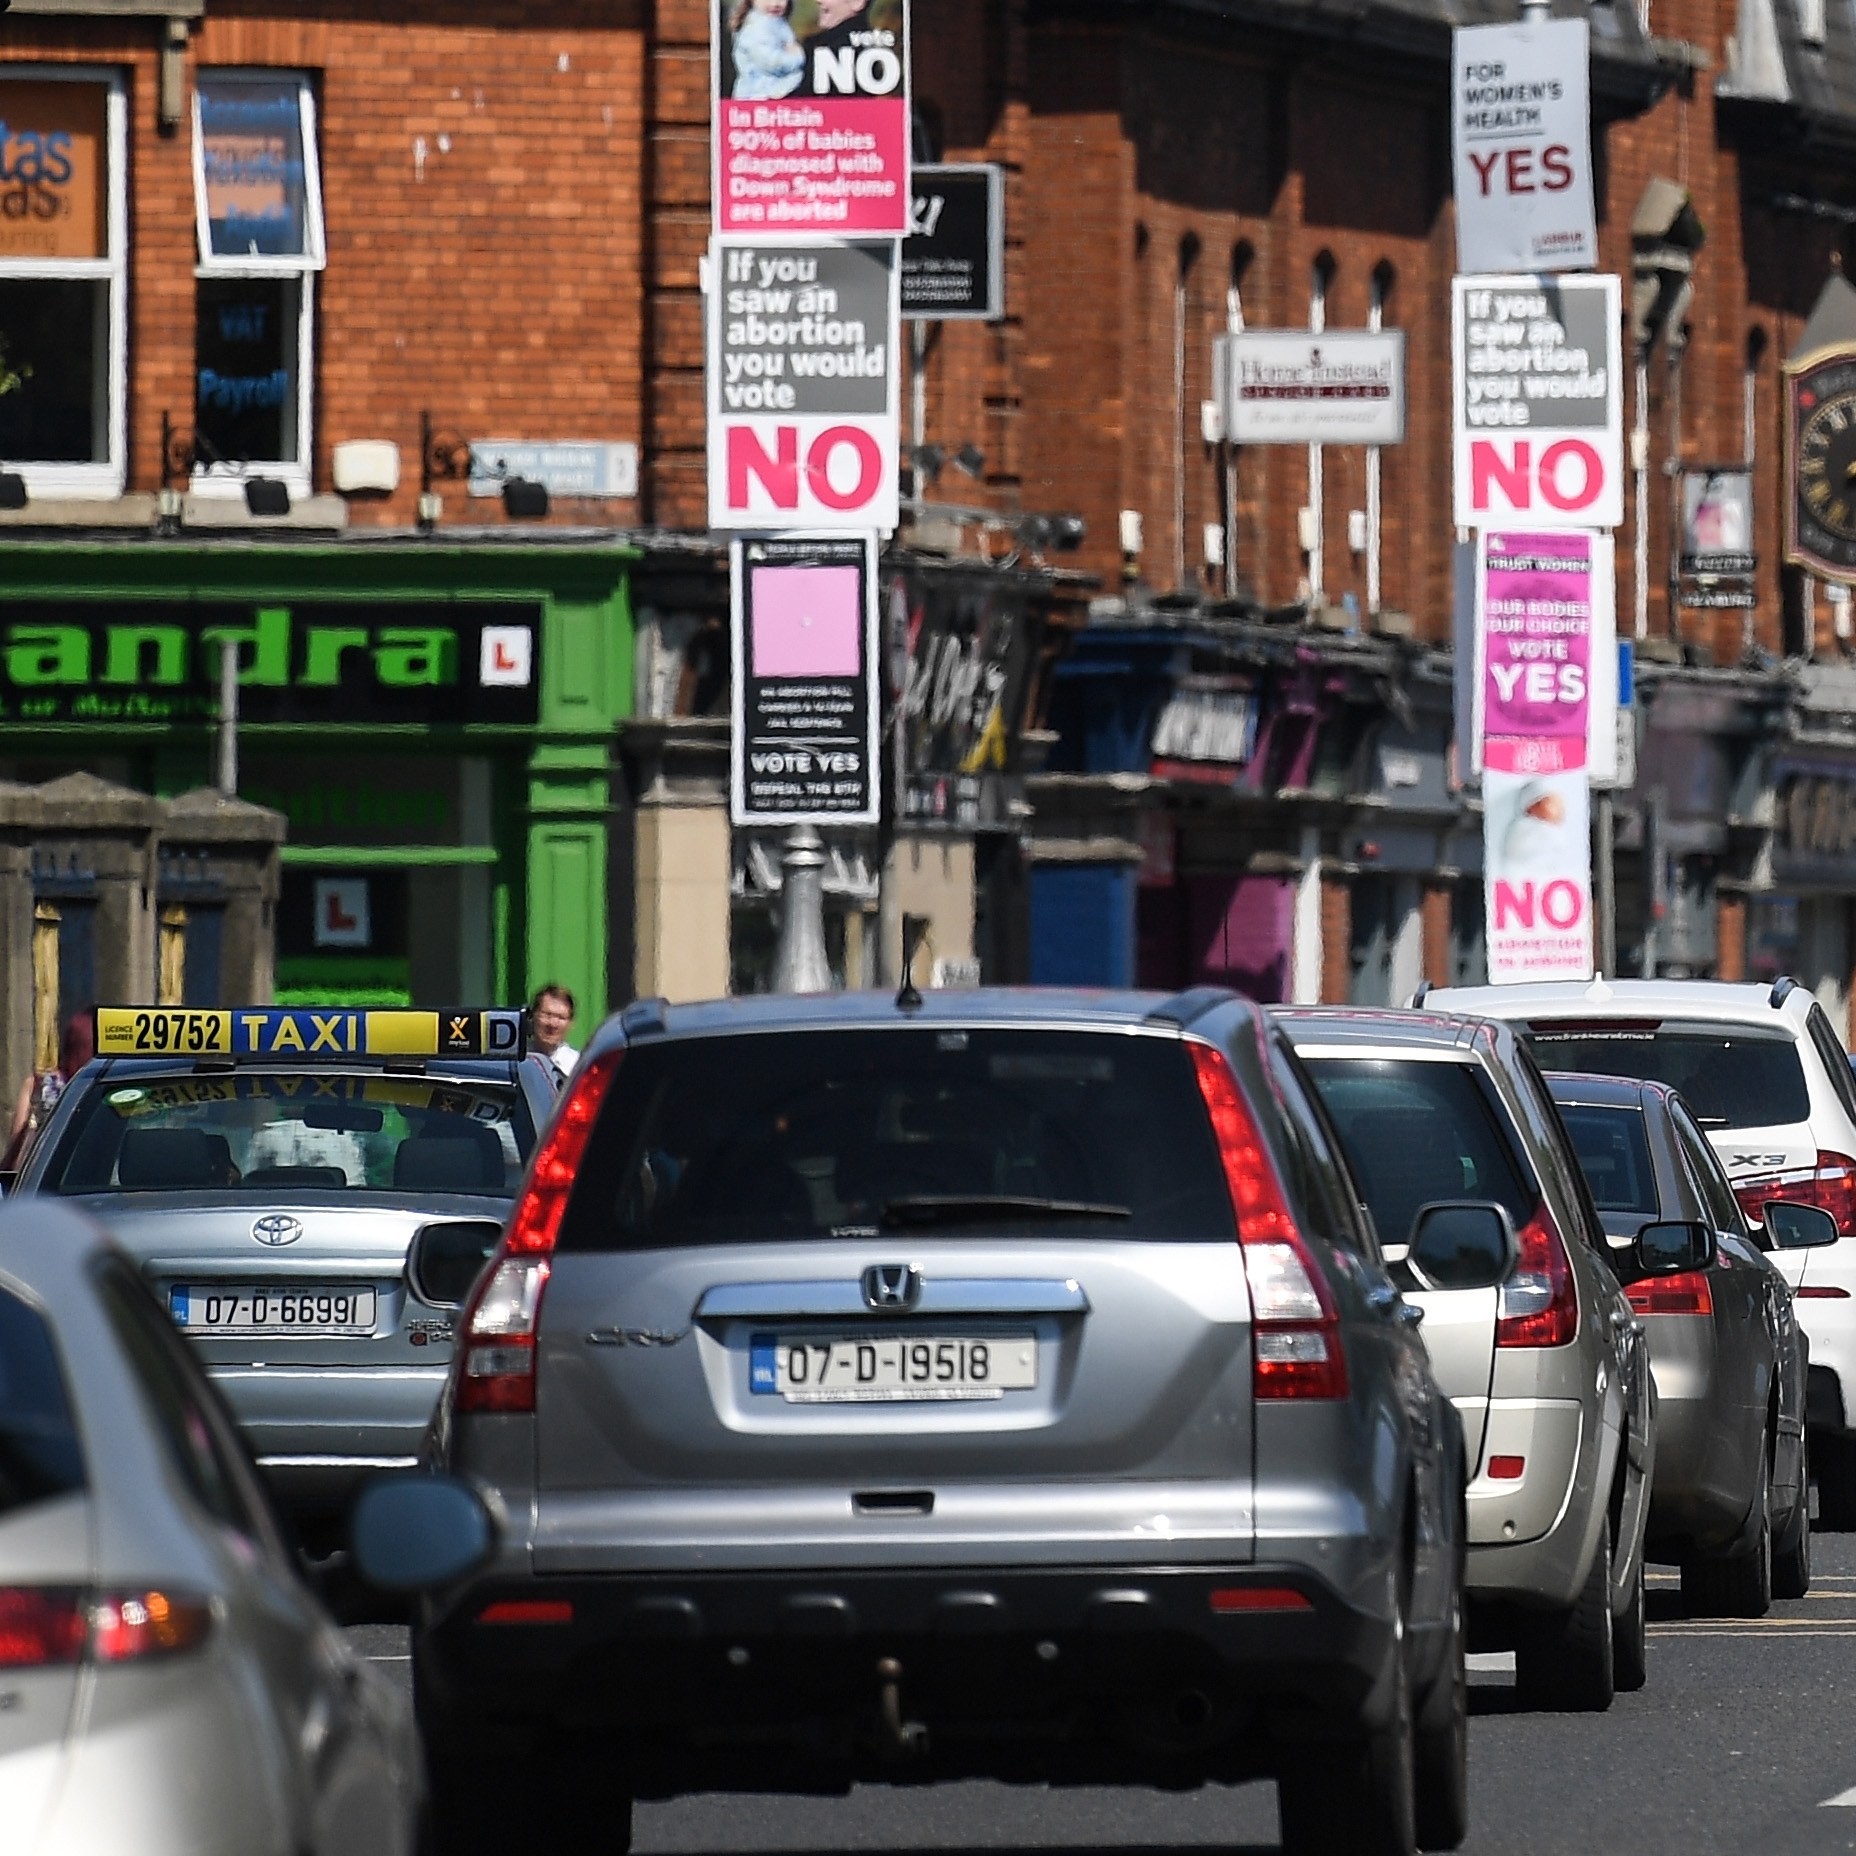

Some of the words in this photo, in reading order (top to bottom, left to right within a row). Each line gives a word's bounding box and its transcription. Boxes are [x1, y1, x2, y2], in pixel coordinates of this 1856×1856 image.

[849, 29, 895, 47] vote
[813, 46, 900, 95] NO
[1466, 64, 1505, 82] FOR
[1466, 81, 1563, 105] WOMEN'S
[729, 107, 751, 127] In
[755, 107, 823, 128] Britain
[1466, 109, 1542, 129] HEALTH
[729, 130, 781, 151] 90%
[782, 130, 805, 151] of
[809, 131, 876, 152] babies
[729, 153, 835, 177] diagnosed
[838, 154, 884, 174] with
[1469, 144, 1575, 197] YES
[729, 177, 790, 198] Down
[790, 177, 896, 201] Syndrome
[729, 204, 765, 221] are
[768, 200, 848, 222] aborted
[727, 251, 756, 283] If
[758, 257, 818, 288] you
[726, 289, 791, 313] saw
[1467, 290, 1493, 319] If
[1494, 294, 1548, 323] you
[726, 314, 866, 346] abortion
[1467, 321, 1526, 345] saw
[1527, 320, 1566, 345] an
[725, 351, 784, 382] you
[790, 345, 886, 378] would
[1466, 344, 1590, 373] abortion
[725, 379, 797, 410] vote
[1466, 375, 1520, 403] you
[1522, 367, 1607, 399] would
[1466, 401, 1531, 426] vote
[726, 424, 882, 511] NO
[1469, 438, 1605, 512] NO
[1489, 599, 1525, 617] OUR
[1488, 617, 1525, 633] OUR
[494, 640, 515, 671] L
[1507, 639, 1569, 660] VOTE
[1489, 663, 1587, 703] YES
[750, 752, 812, 774] VOTE
[815, 752, 861, 773] YES
[325, 892, 356, 931] L
[1493, 879, 1583, 930] NO
[104, 1033, 134, 1042] NUMBER
[135, 1013, 221, 1050] 29752
[241, 1014, 357, 1052] TAXI
[489, 1018, 518, 1050] D
[1728, 1154, 1787, 1168] X3
[205, 1295, 357, 1324] 07-D-66991
[788, 1341, 989, 1385] 07-D-19518
